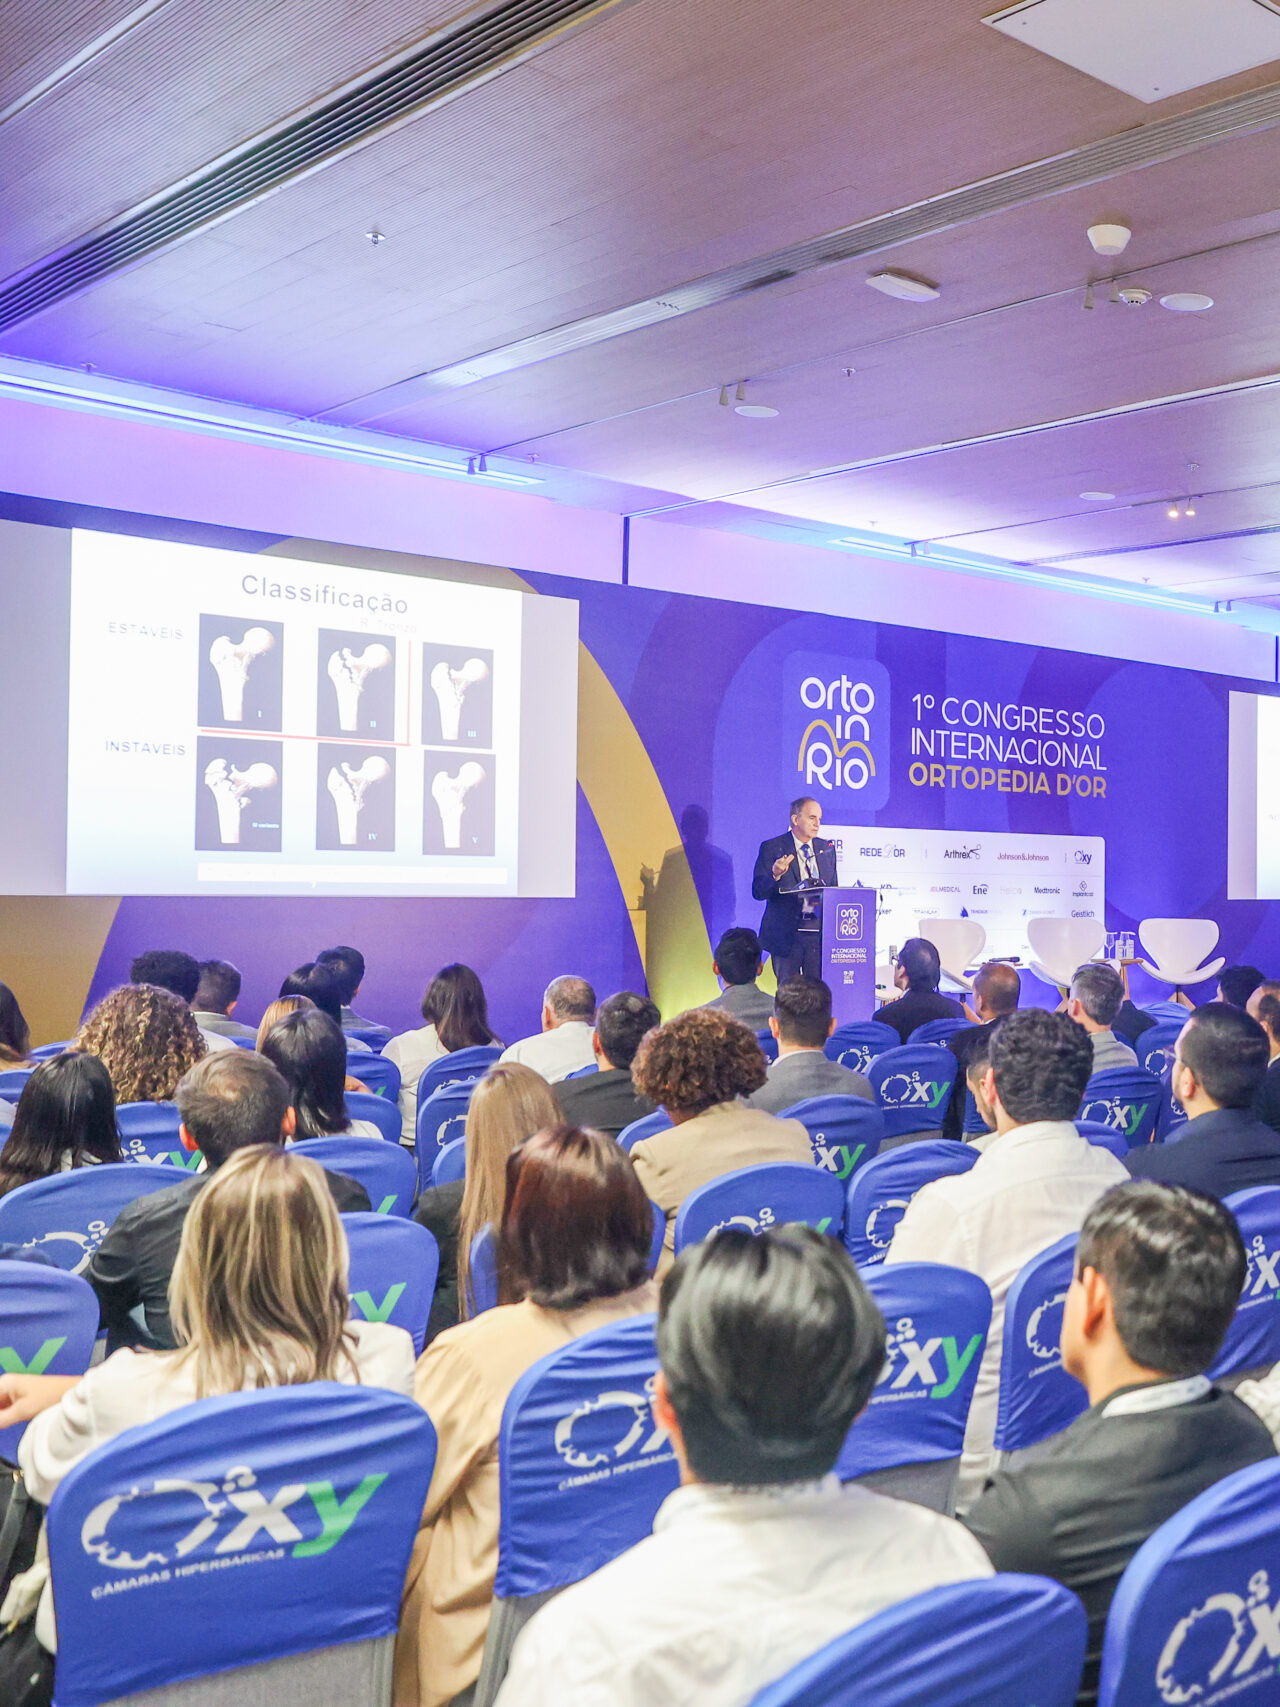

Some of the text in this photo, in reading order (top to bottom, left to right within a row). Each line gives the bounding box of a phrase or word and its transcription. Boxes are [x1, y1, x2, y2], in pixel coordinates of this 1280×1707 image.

[241, 574, 408, 615] Classificação
[800, 674, 875, 713] orto
[835, 714, 870, 741] in
[941, 697, 1105, 739] CONGRESSO
[806, 741, 869, 790] Rio
[911, 727, 1107, 771] INTERNACIONAL
[908, 762, 1107, 798] ORTOPEDIA D'OR
[860, 847, 882, 857] REDE
[944, 849, 971, 859] Arthrex
[997, 852, 1049, 861] Johnson&Johnson
[841, 908, 859, 917] orto
[1071, 909, 1094, 918] Geistlich
[837, 1047, 880, 1074] Ox
[880, 1070, 950, 1108] Oxy
[1082, 1099, 1149, 1136] Oxy
[815, 1143, 867, 1180] xy
[876, 1332, 984, 1399] xy
[81, 1468, 389, 1569] Oxy
